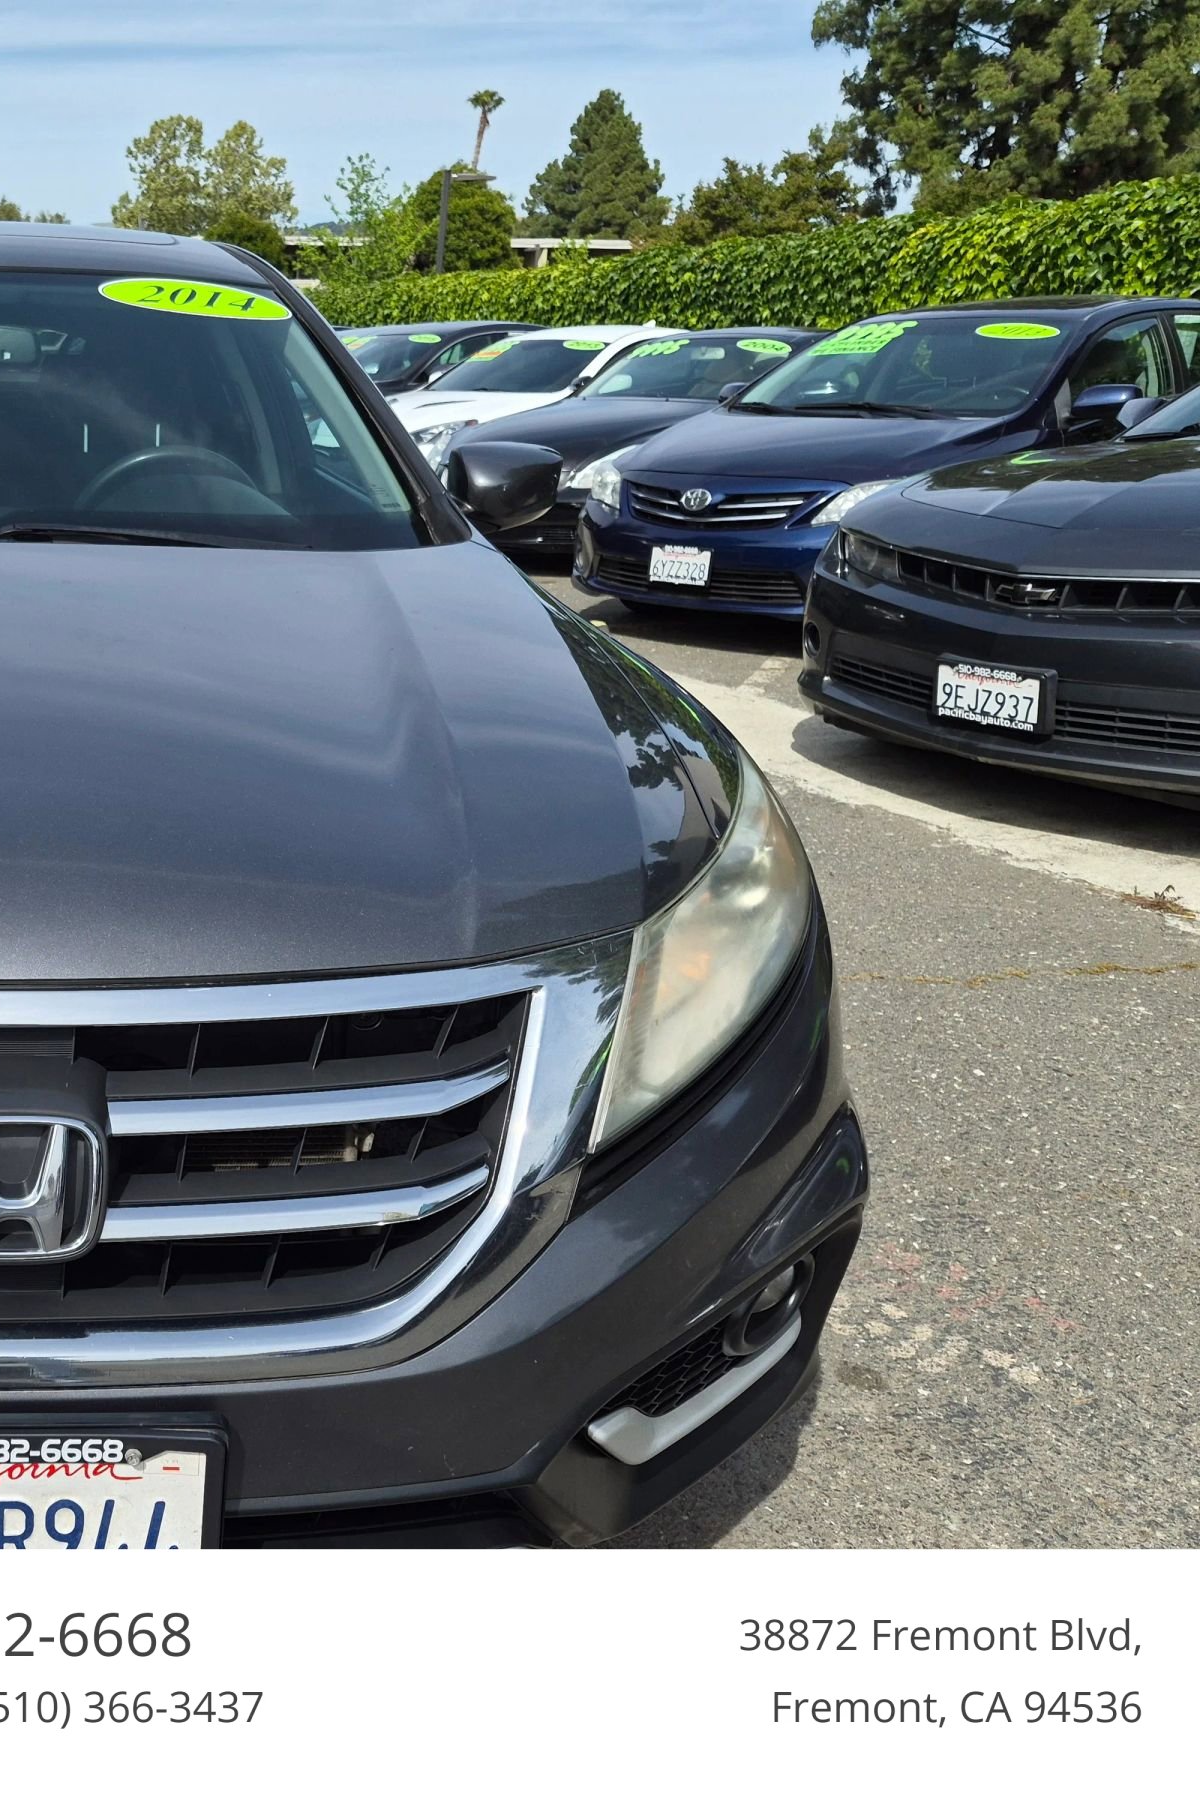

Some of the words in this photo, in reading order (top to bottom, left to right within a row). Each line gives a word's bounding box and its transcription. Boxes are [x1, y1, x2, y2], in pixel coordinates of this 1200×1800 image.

[136, 285, 256, 312] 2014
[653, 559, 706, 580] 6YZZ328
[958, 664, 1017, 681] 510-982-6668
[941, 683, 1034, 723] 9EJZ937
[938, 706, 1034, 732] pacificbayauto.com
